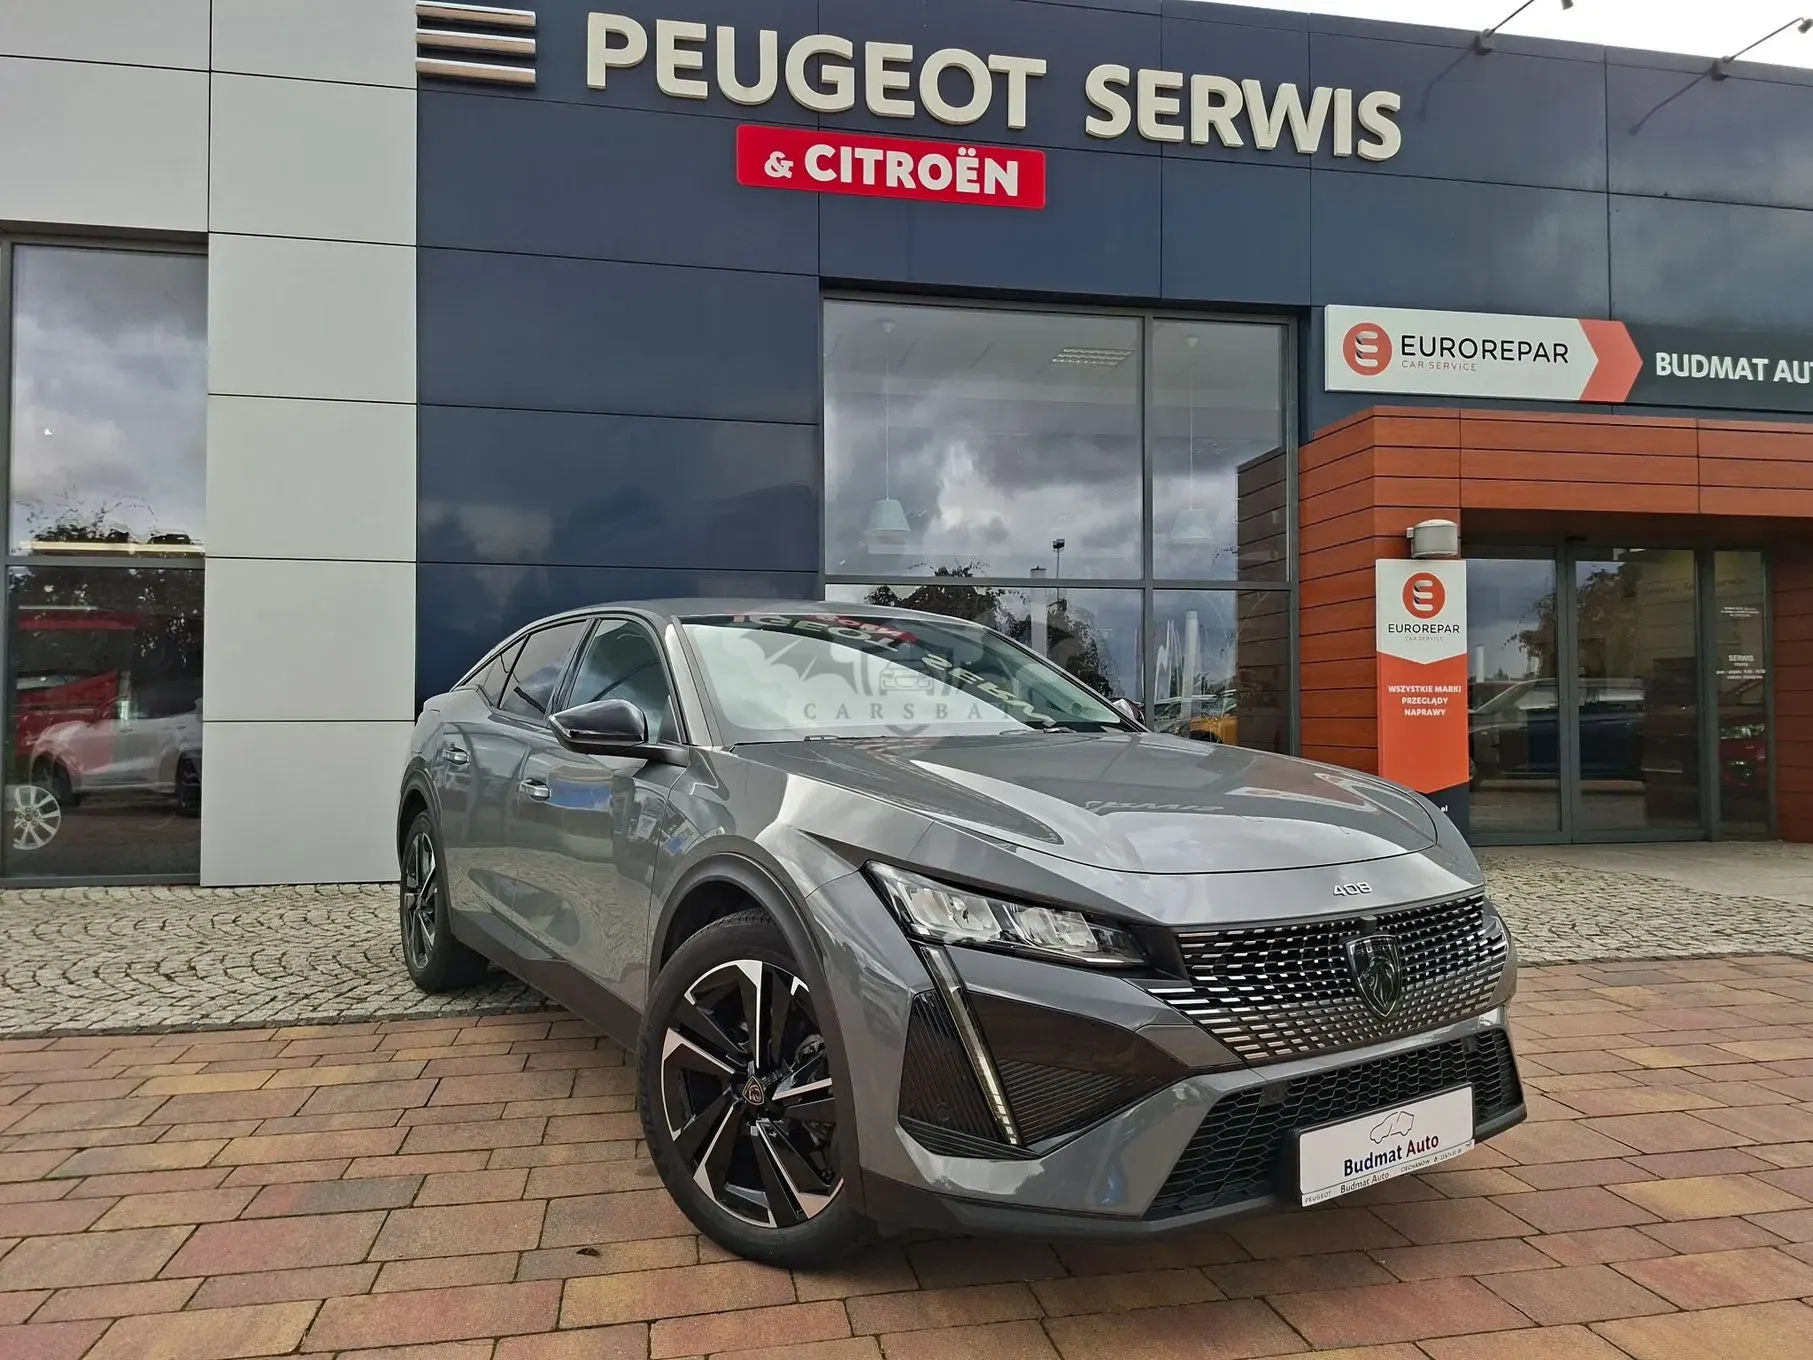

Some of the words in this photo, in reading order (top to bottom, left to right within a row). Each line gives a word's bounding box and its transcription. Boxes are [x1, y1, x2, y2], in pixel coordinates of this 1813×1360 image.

[586, 12, 1047, 130] PEUGEOT
[1085, 63, 1402, 161] SERWIS
[763, 149, 794, 179] &
[804, 143, 1019, 199] CITROËN
[1400, 334, 1570, 365] EUROREPAR
[1401, 359, 1425, 370] CAR
[1428, 362, 1477, 373] SERVICE
[1655, 352, 1769, 381] BUDMAT
[1773, 359, 1813, 384] AU
[1388, 623, 1460, 634] EUROREPAR
[1388, 685, 1433, 693] WSZYSTKIE
[1434, 685, 1462, 693] MARKI
[1401, 697, 1449, 706] PRZEGLĄDY
[1333, 882, 1372, 896] 408
[1343, 1147, 1403, 1178] Budmat
[1406, 1135, 1440, 1158] Auto
[1340, 1178, 1370, 1194] Budmat
[1371, 1171, 1390, 1184] Auto
